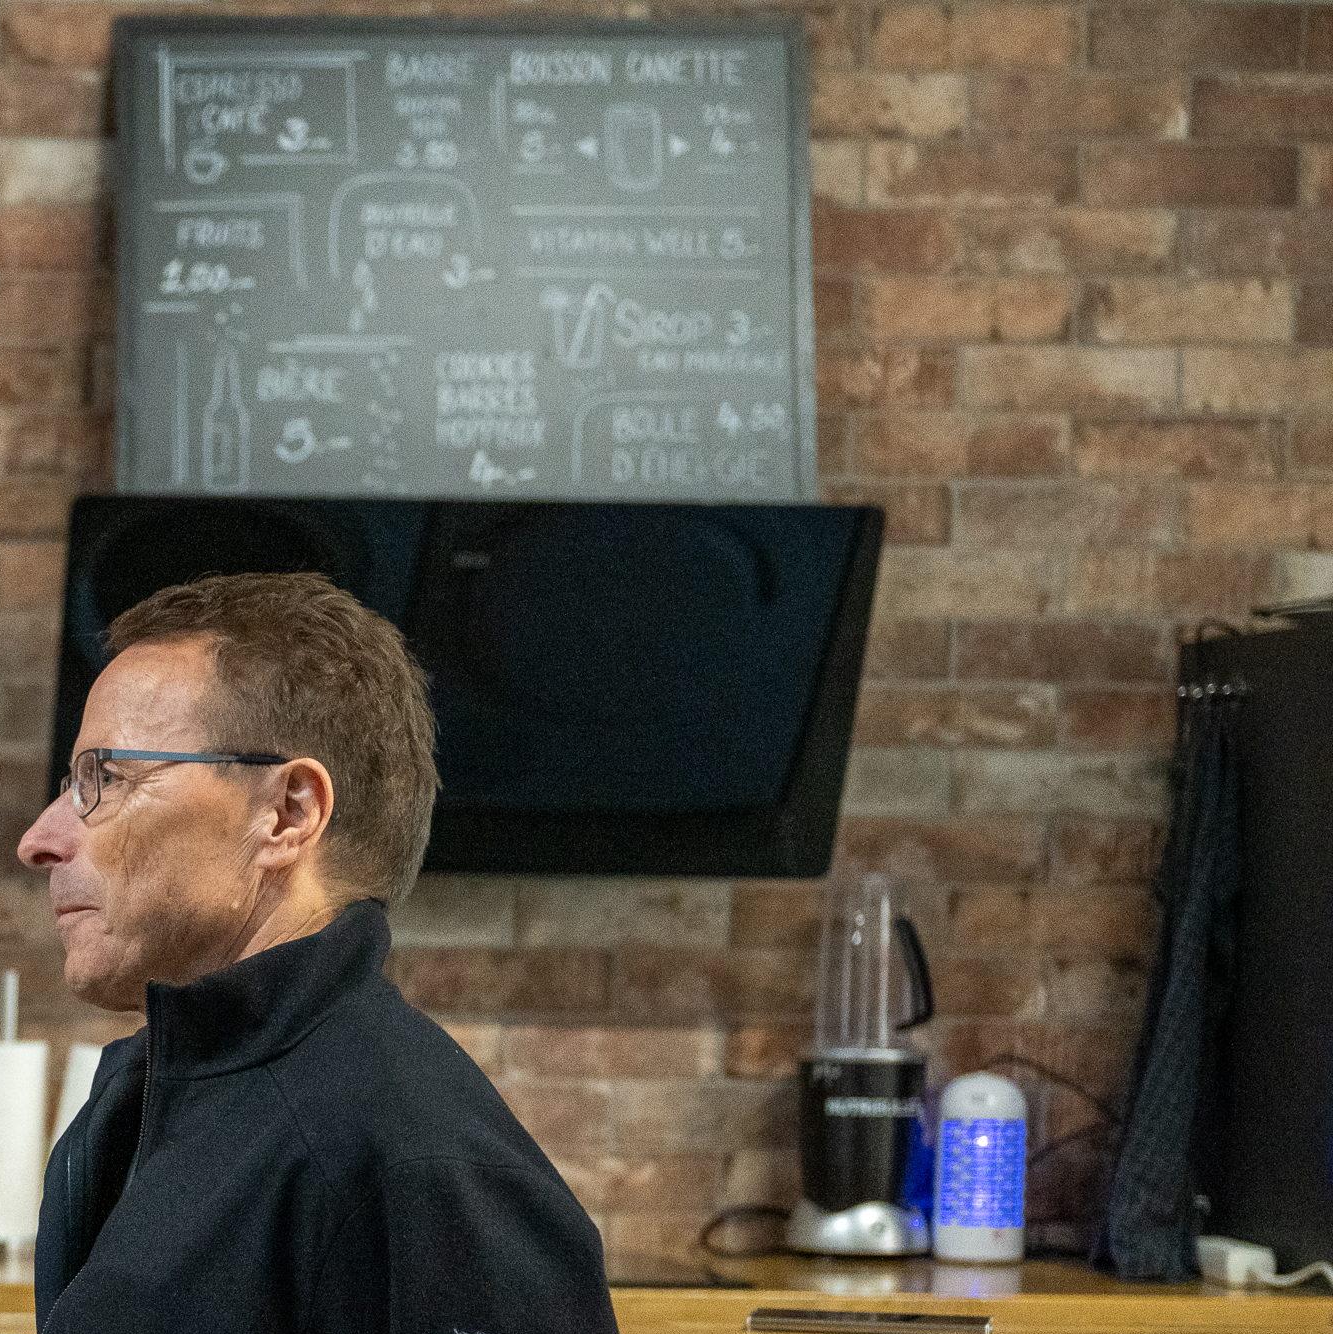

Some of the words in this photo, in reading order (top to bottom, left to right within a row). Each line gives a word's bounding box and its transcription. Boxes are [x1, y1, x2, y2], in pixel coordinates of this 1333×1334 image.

[384, 50, 475, 88] BARRE
[510, 49, 614, 86] BOISSON
[625, 49, 748, 86] CANETTE
[611, 405, 700, 445] BOULE
